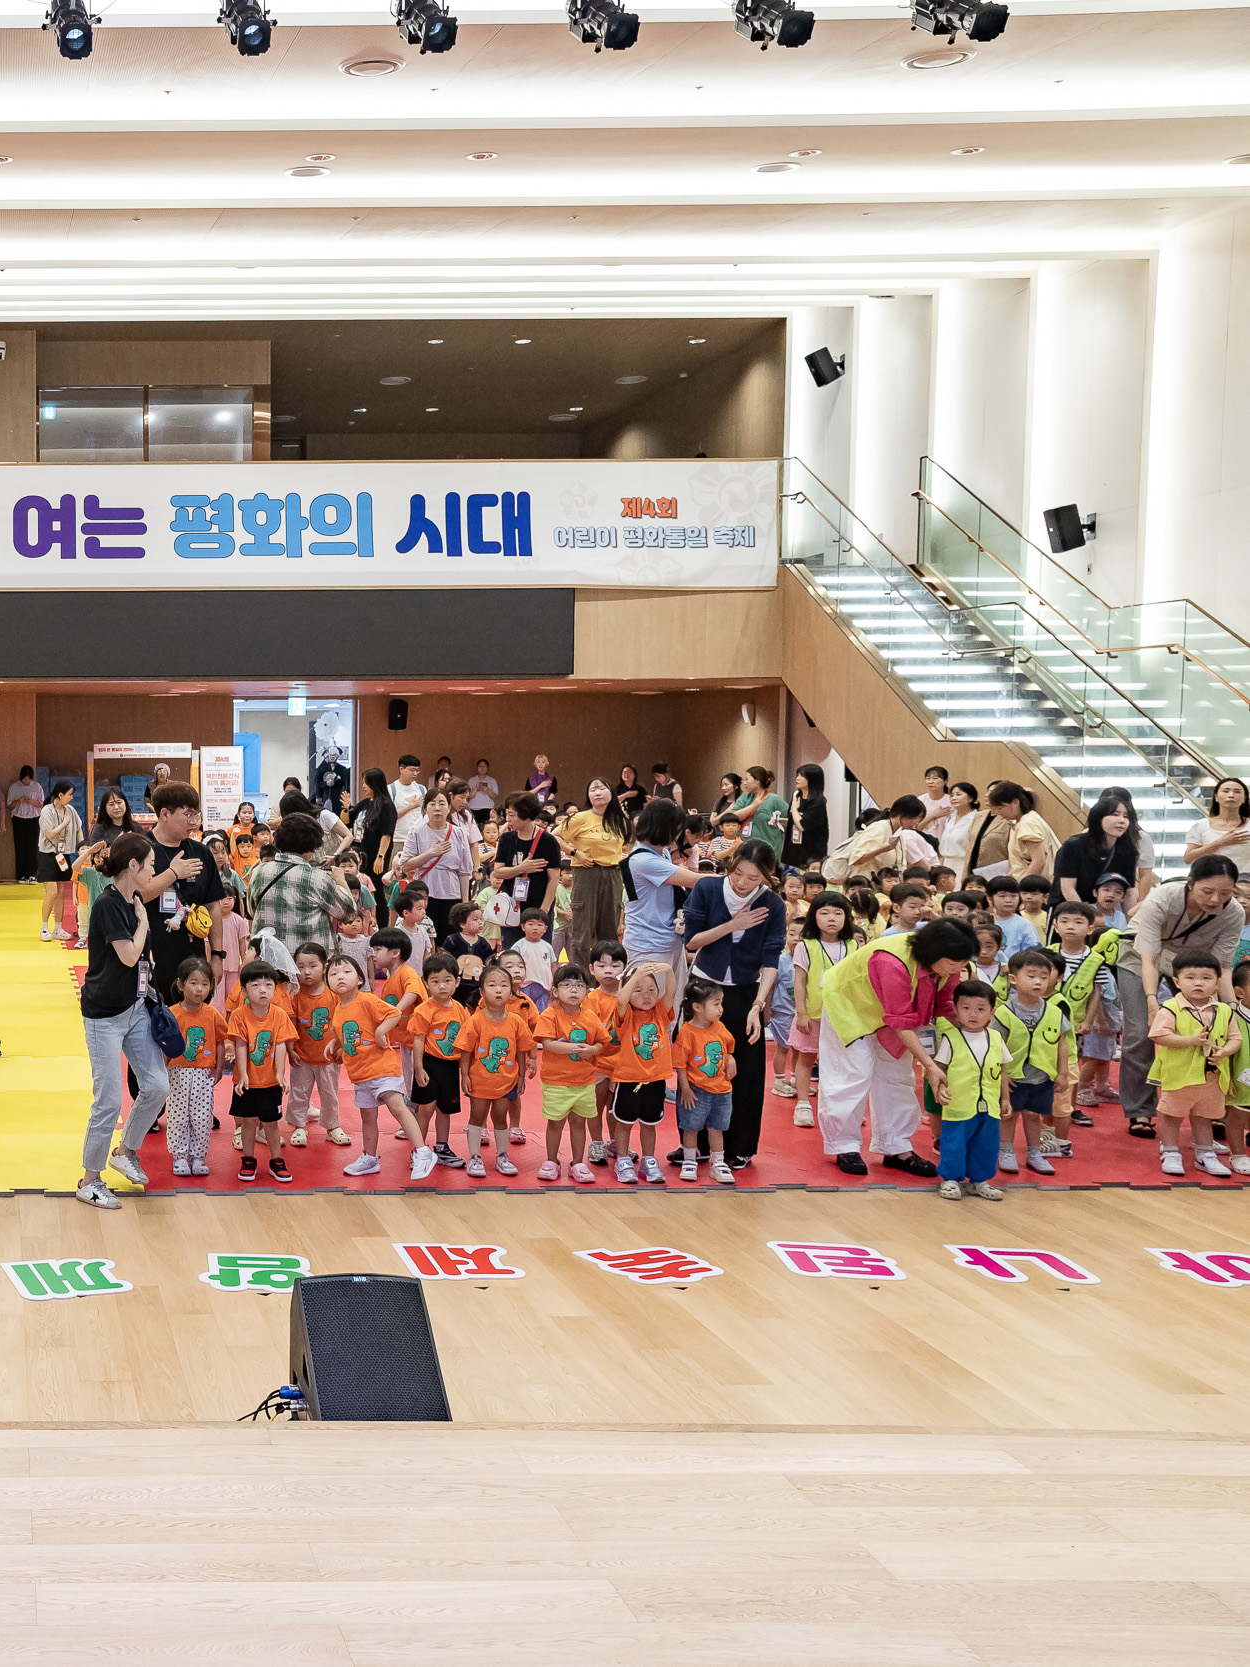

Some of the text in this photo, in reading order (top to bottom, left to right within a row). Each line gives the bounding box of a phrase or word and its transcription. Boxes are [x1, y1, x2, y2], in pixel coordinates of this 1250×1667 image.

[621, 497, 677, 518] 제4회
[14, 494, 146, 559] 여는
[170, 492, 374, 558] 평화의
[396, 491, 532, 556] 시대
[553, 525, 756, 549] 어린이 평화통일 축제
[404, 1247, 514, 1276] 제
[778, 1245, 894, 1276] 된
[959, 1248, 1086, 1280] 나
